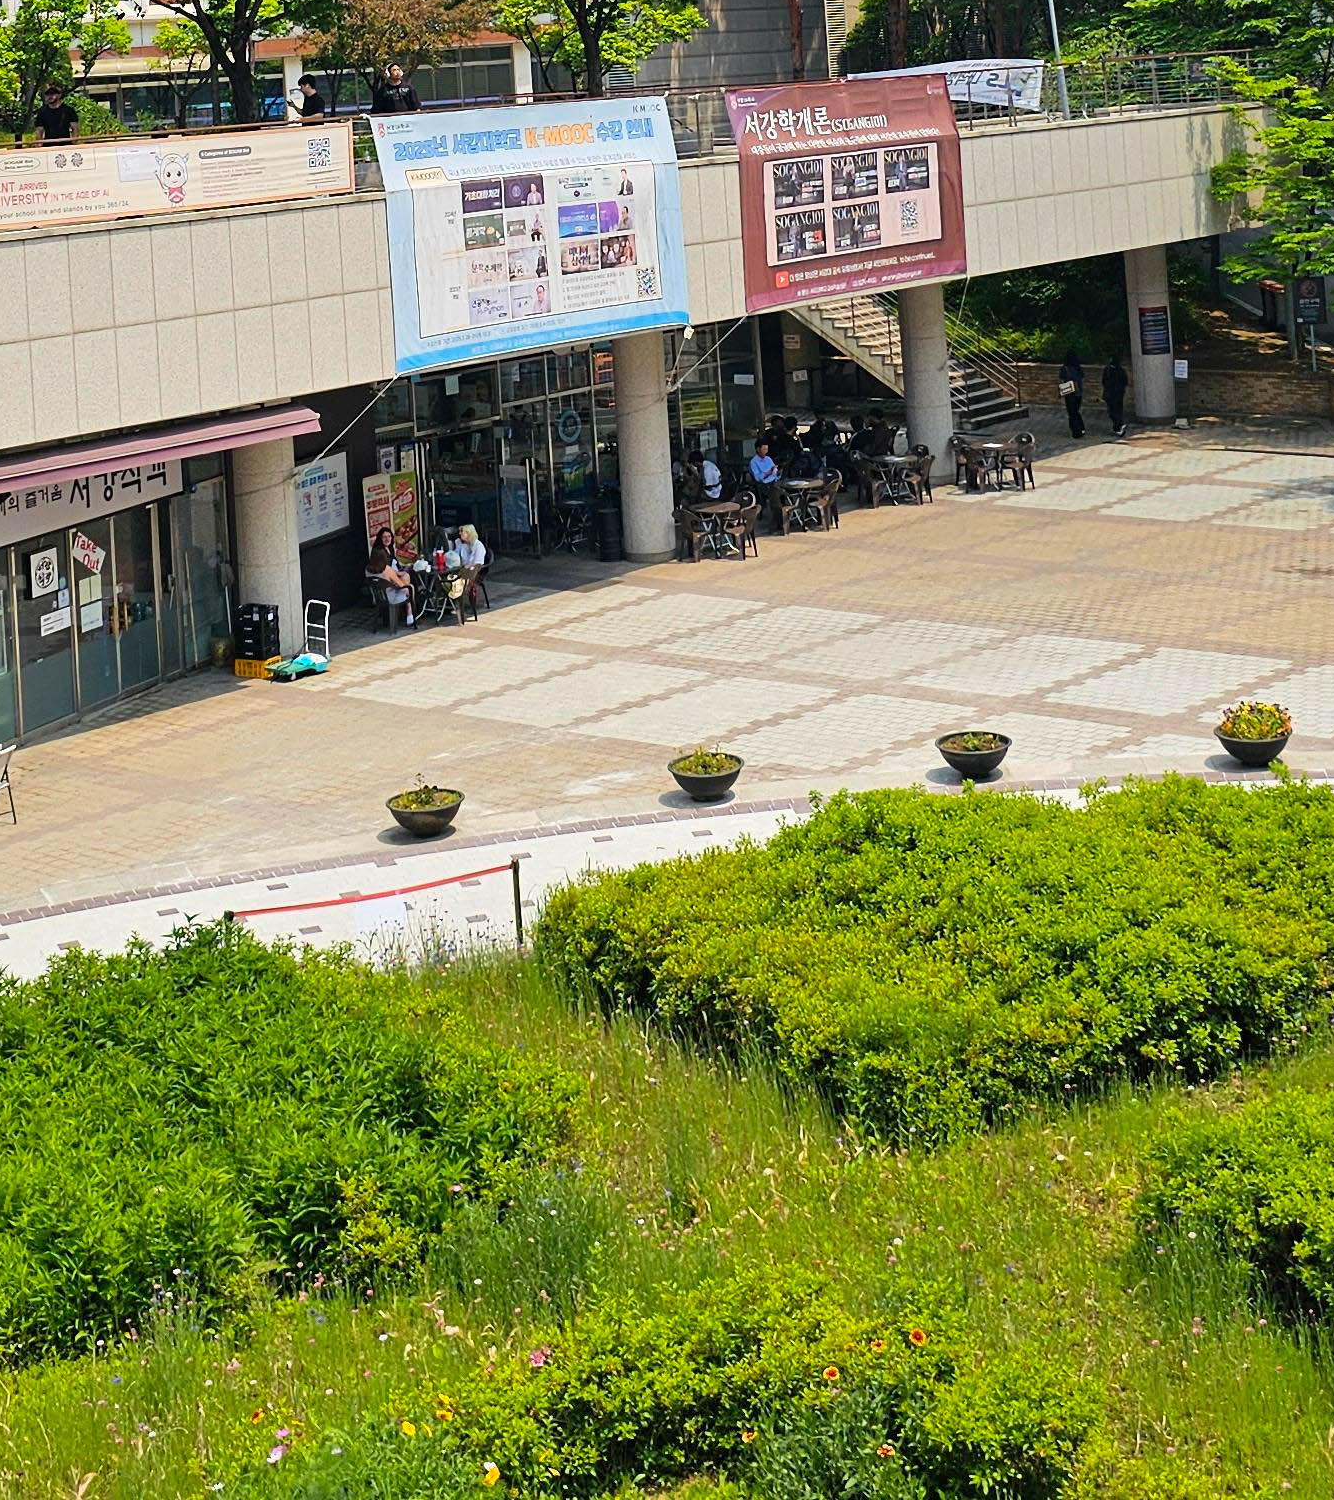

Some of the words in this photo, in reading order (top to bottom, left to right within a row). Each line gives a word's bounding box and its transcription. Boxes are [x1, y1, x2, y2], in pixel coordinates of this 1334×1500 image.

[394, 136, 448, 162] 2025년
[452, 128, 522, 155] 서강대학교
[524, 122, 594, 148] K-MOOC
[596, 120, 623, 141] 수강
[625, 117, 655, 139] 안내
[18, 182, 48, 192] ARRIVES
[50, 193, 60, 201] IN
[61, 193, 74, 201] THE
[91, 190, 102, 198] OF
[0, 211, 14, 221] your
[15, 208, 37, 218] school
[50, 206, 61, 215] and
[62, 204, 83, 213] stands
[85, 204, 93, 212] by
[94, 202, 106, 211] you
[25, 484, 62, 509] 즐거움
[76, 534, 98, 554] Take
[82, 553, 100, 571] Out
